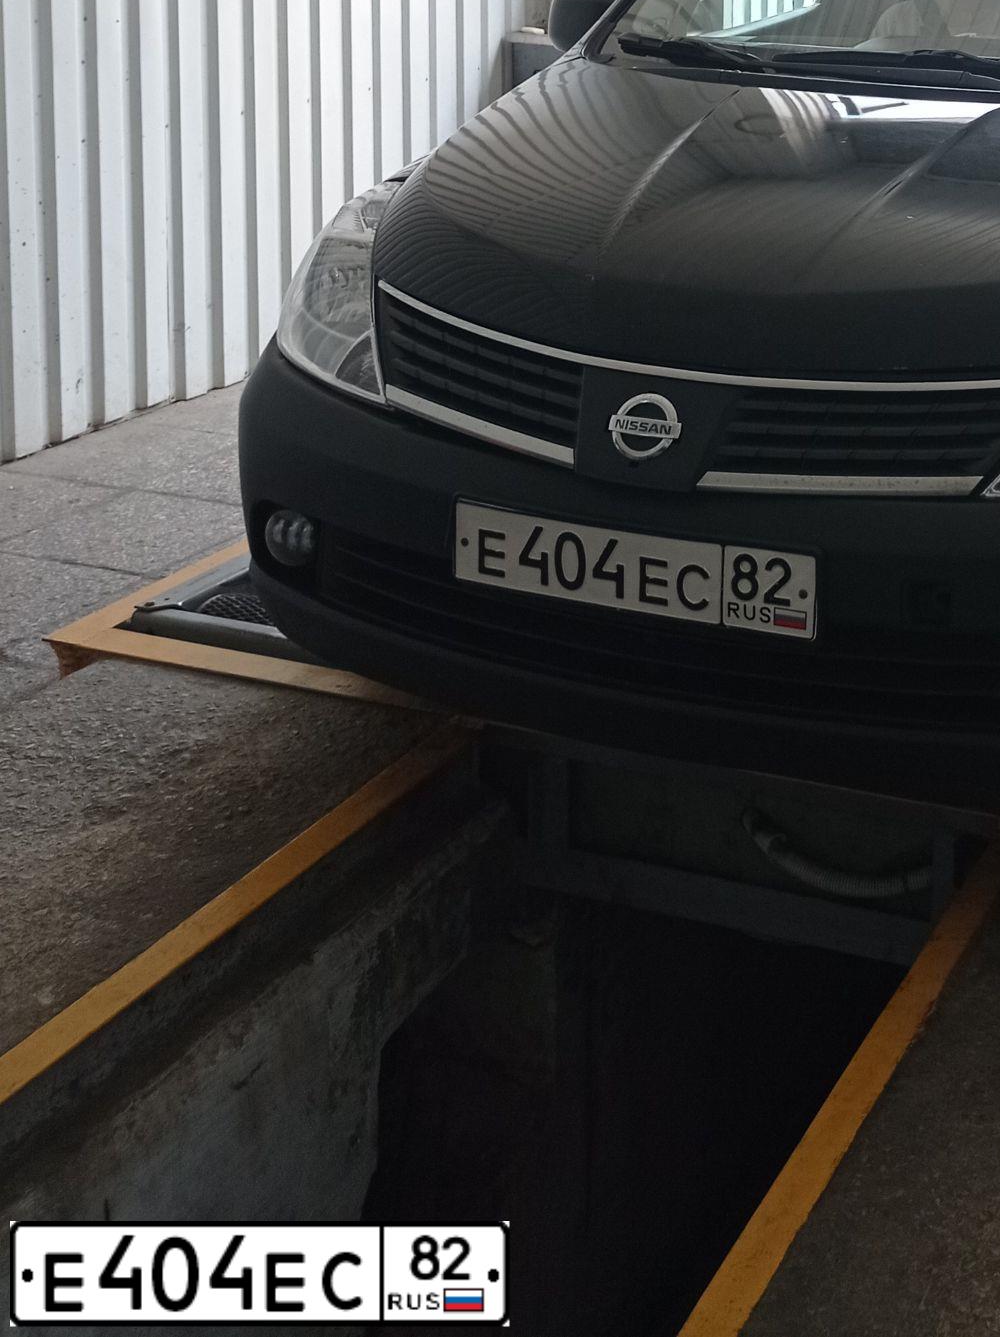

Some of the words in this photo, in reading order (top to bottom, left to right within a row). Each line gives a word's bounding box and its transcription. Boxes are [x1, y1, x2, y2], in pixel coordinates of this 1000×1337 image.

[614, 418, 672, 435] NISSAN
[731, 553, 792, 607] 82
[727, 601, 771, 623] RUS
